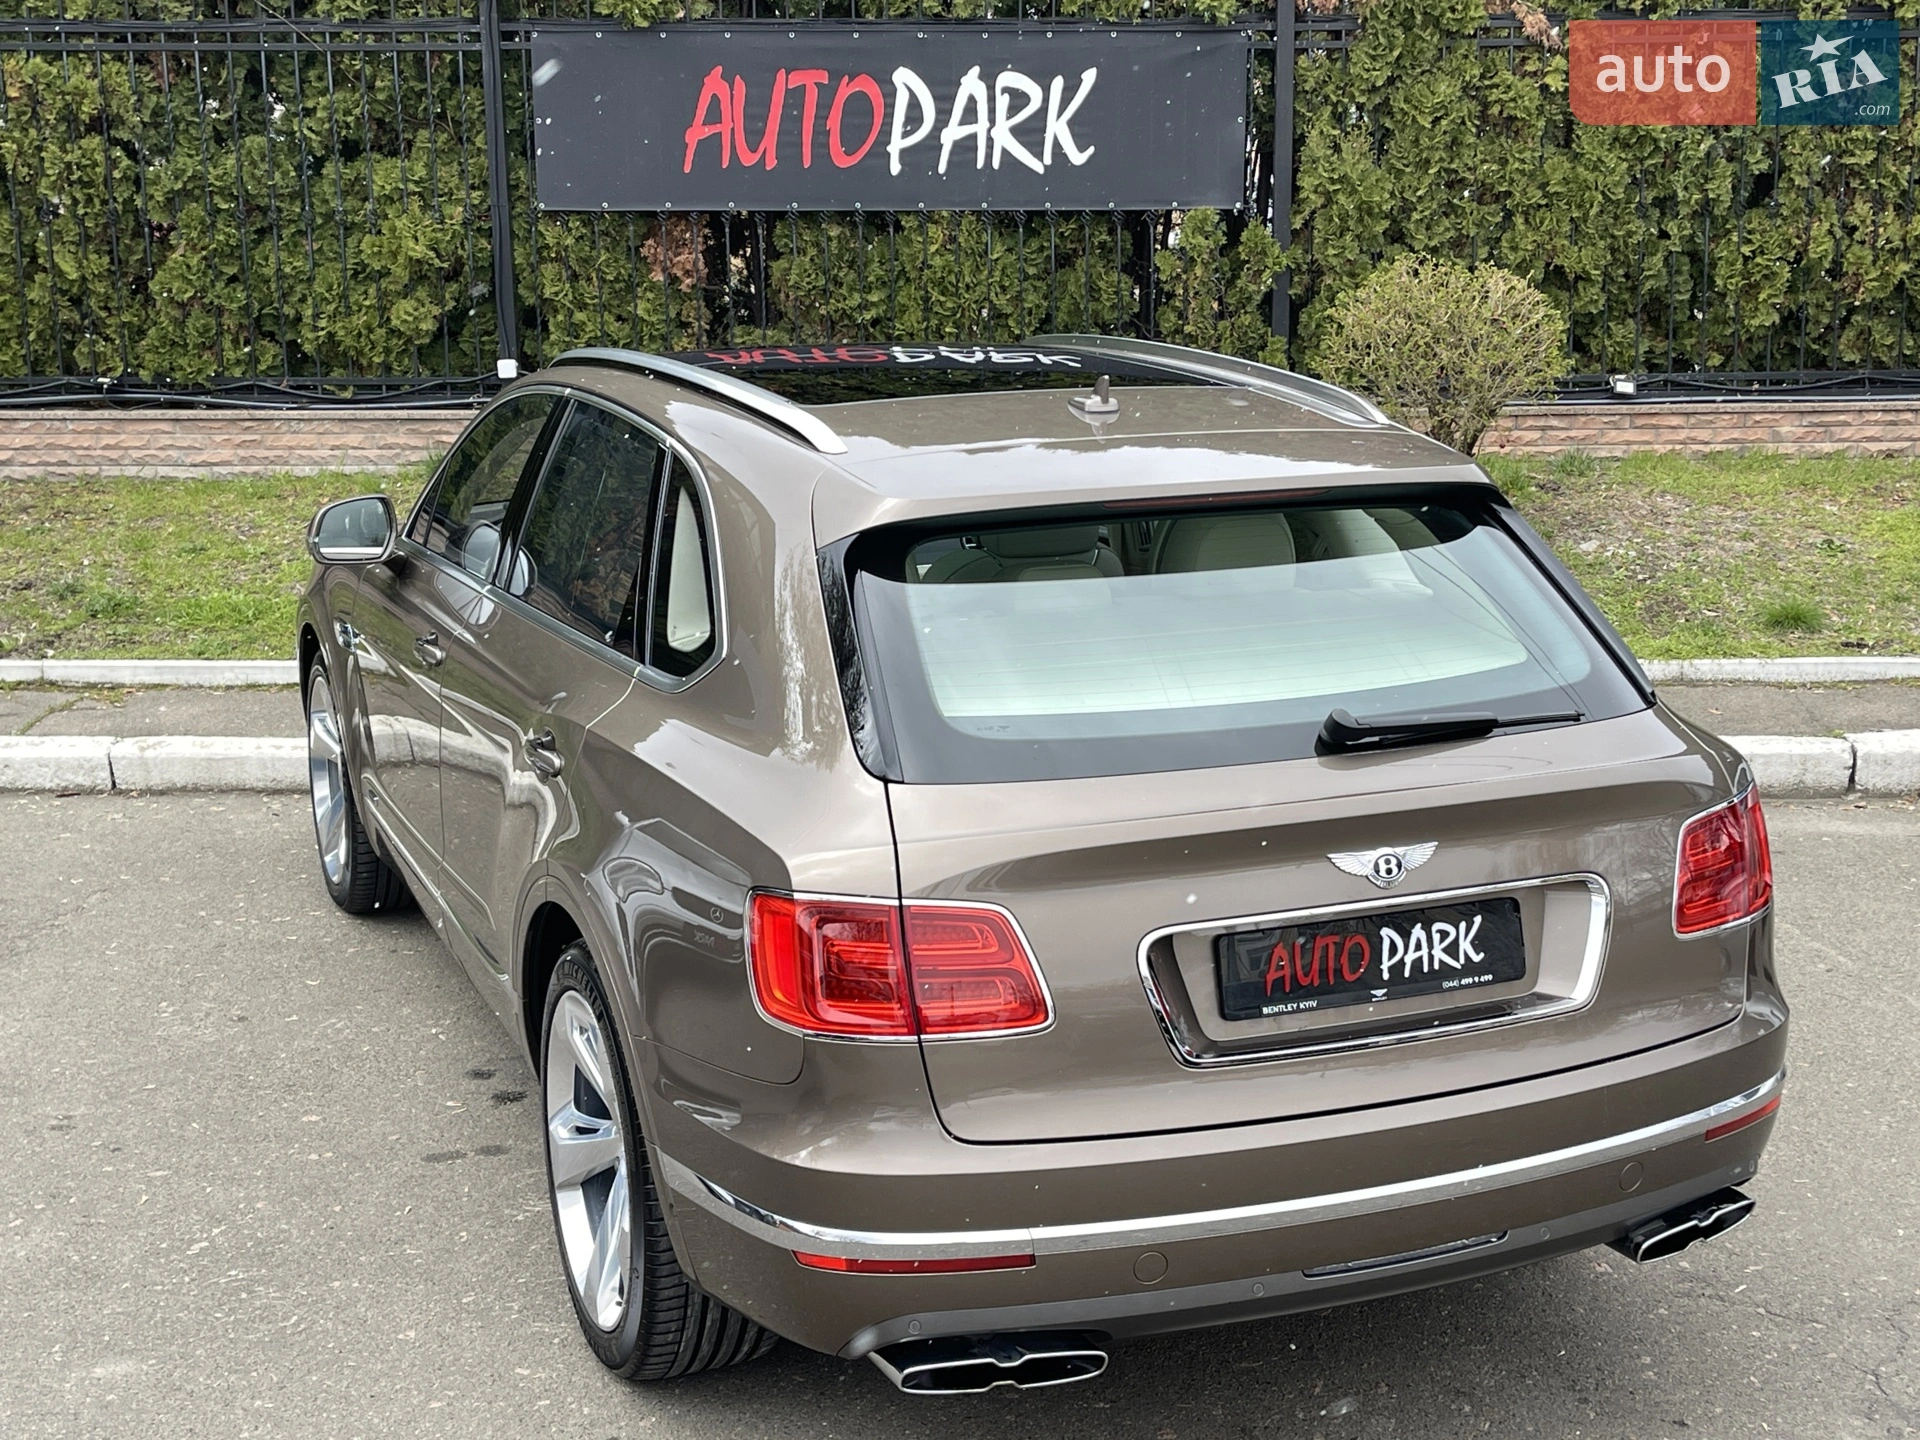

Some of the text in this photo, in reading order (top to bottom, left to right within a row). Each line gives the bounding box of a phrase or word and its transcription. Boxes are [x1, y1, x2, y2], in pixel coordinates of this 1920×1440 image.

[1264, 914, 1485, 997] AUTO PARK
[1441, 979, 1460, 989] (044)
[1460, 977, 1473, 985] 499
[1480, 974, 1494, 983] 499
[1262, 1000, 1318, 1015] BENTLEY KYIV
